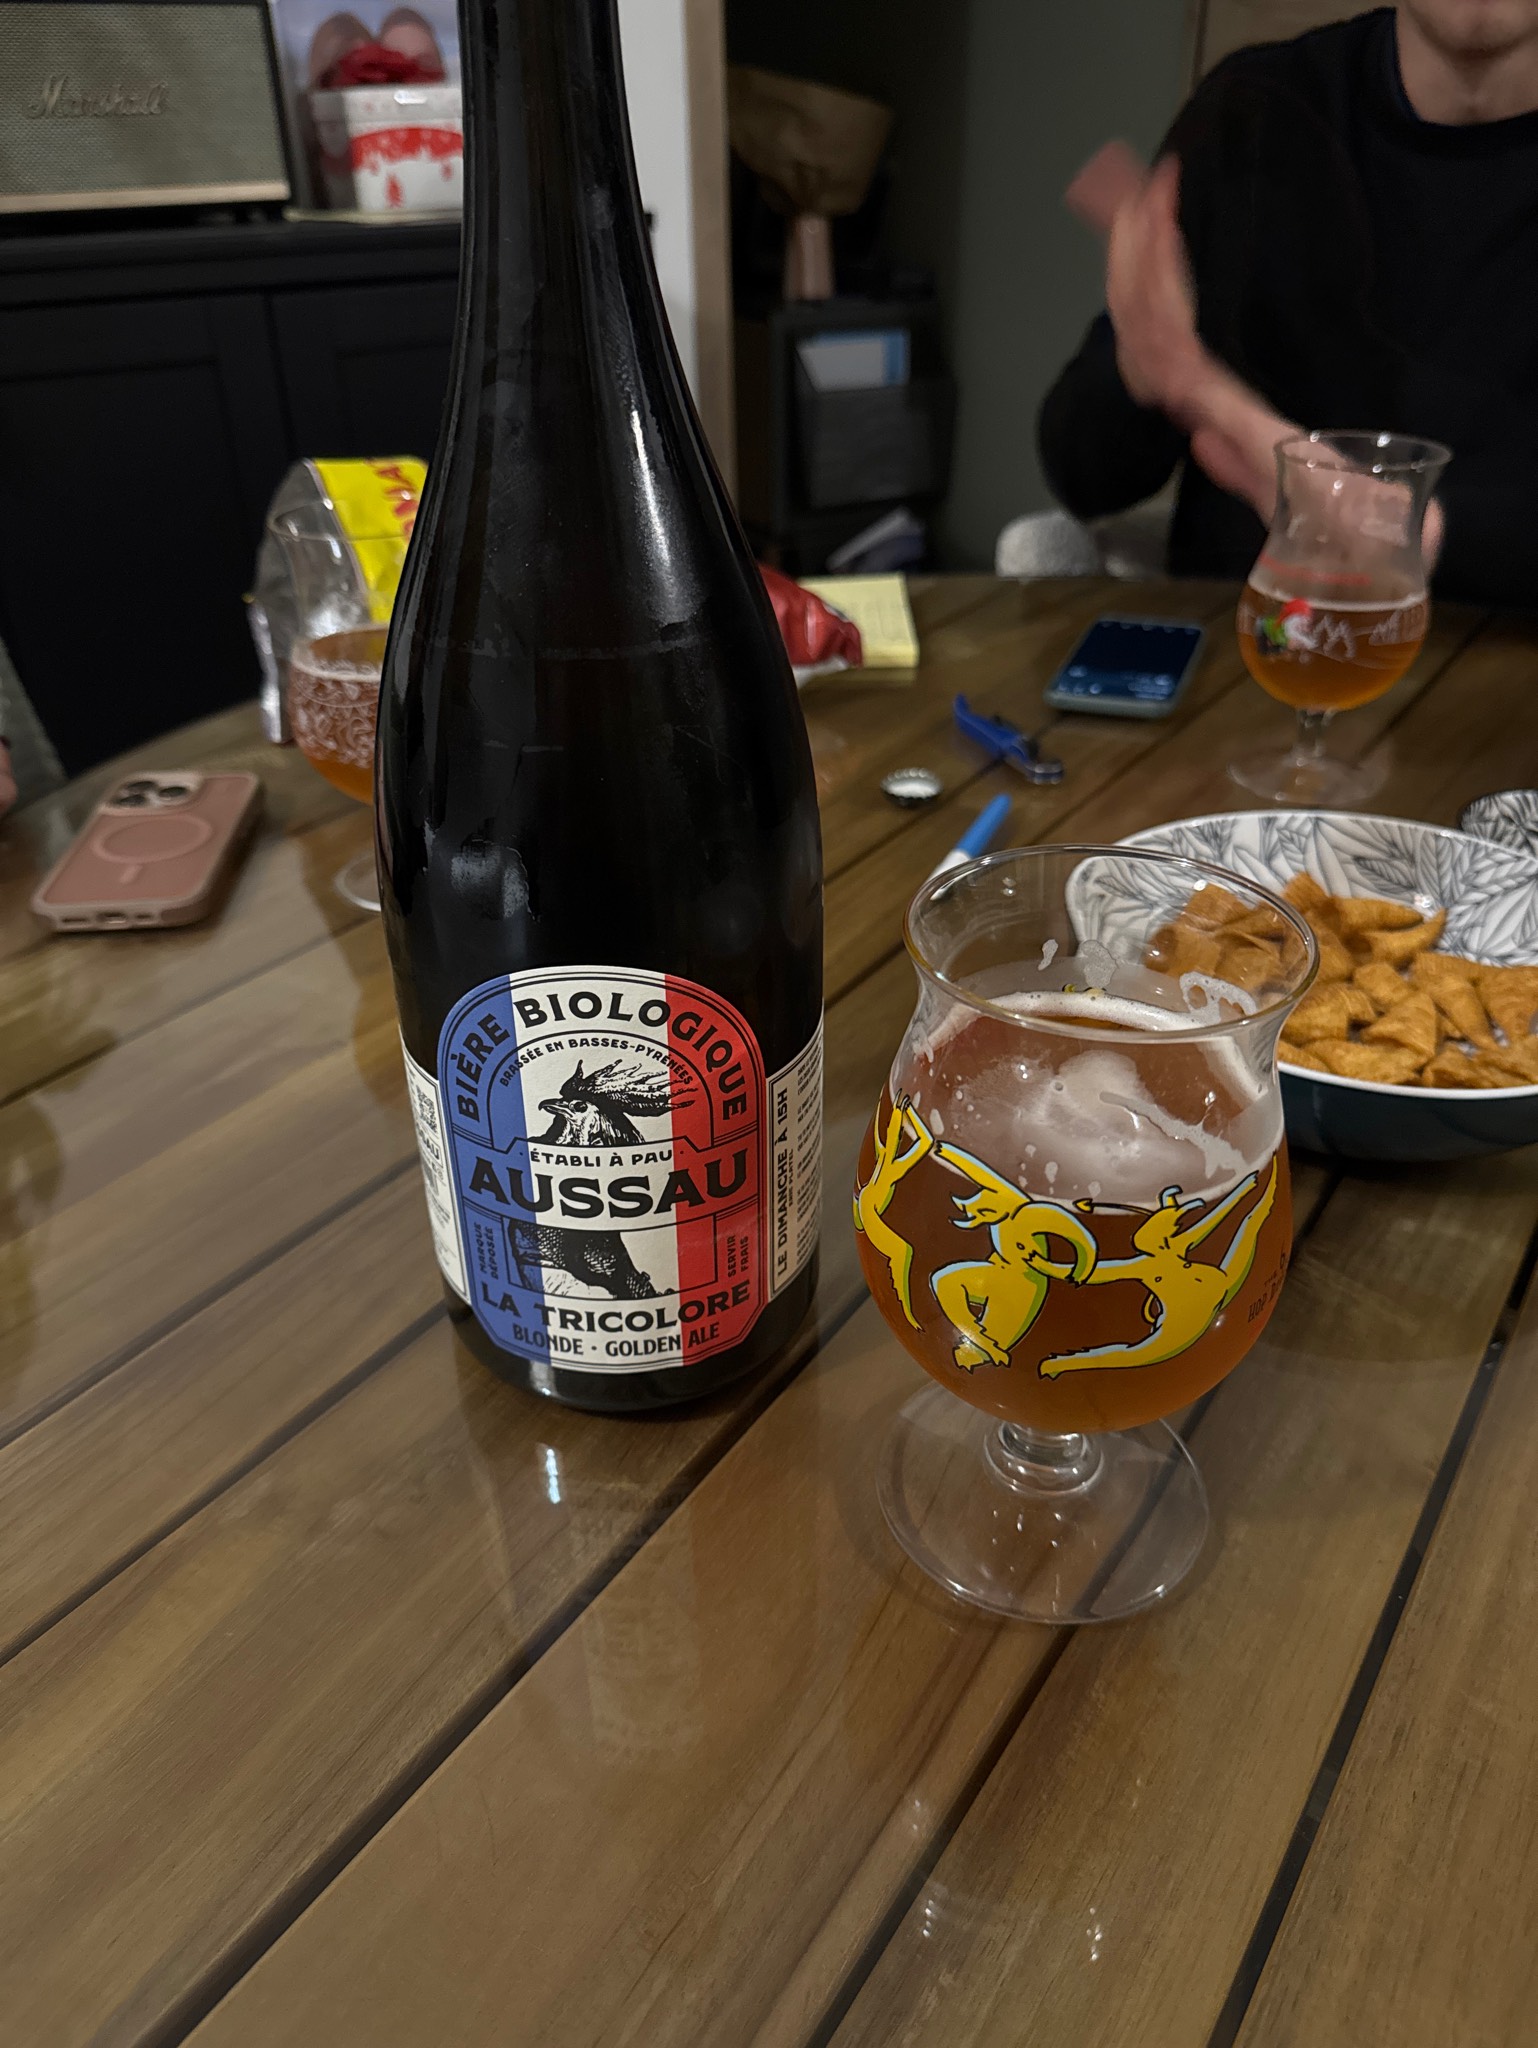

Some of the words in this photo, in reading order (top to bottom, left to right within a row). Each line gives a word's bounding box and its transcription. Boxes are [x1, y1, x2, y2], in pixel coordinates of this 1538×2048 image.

[451, 1013, 510, 1122] BIÈRE
[513, 991, 747, 1121] BIOLOGIQUE
[500, 1048, 544, 1087] BRASSÉE
[545, 1041, 564, 1053] EN
[568, 1037, 693, 1085] BASSES-PYRÉNÉES
[777, 1087, 788, 1125] 15H
[530, 1148, 601, 1167] ÉTABLI
[609, 1152, 624, 1167] À
[631, 1150, 672, 1166] PAU
[774, 1127, 788, 1146] À
[469, 1148, 748, 1219] AUSSAU
[777, 1148, 788, 1246] DIMANCHE
[474, 1222, 487, 1274] MARQUE
[485, 1226, 498, 1280] DÉPOSÉE
[728, 1234, 737, 1277] SERVIR
[740, 1236, 749, 1273] FRAIS
[777, 1250, 788, 1276] LE
[481, 1281, 522, 1318] LA
[534, 1280, 751, 1333] TRICOLORE
[512, 1323, 584, 1355] BLONDE
[605, 1334, 682, 1357] GOLDEN
[687, 1321, 720, 1349] ALE
